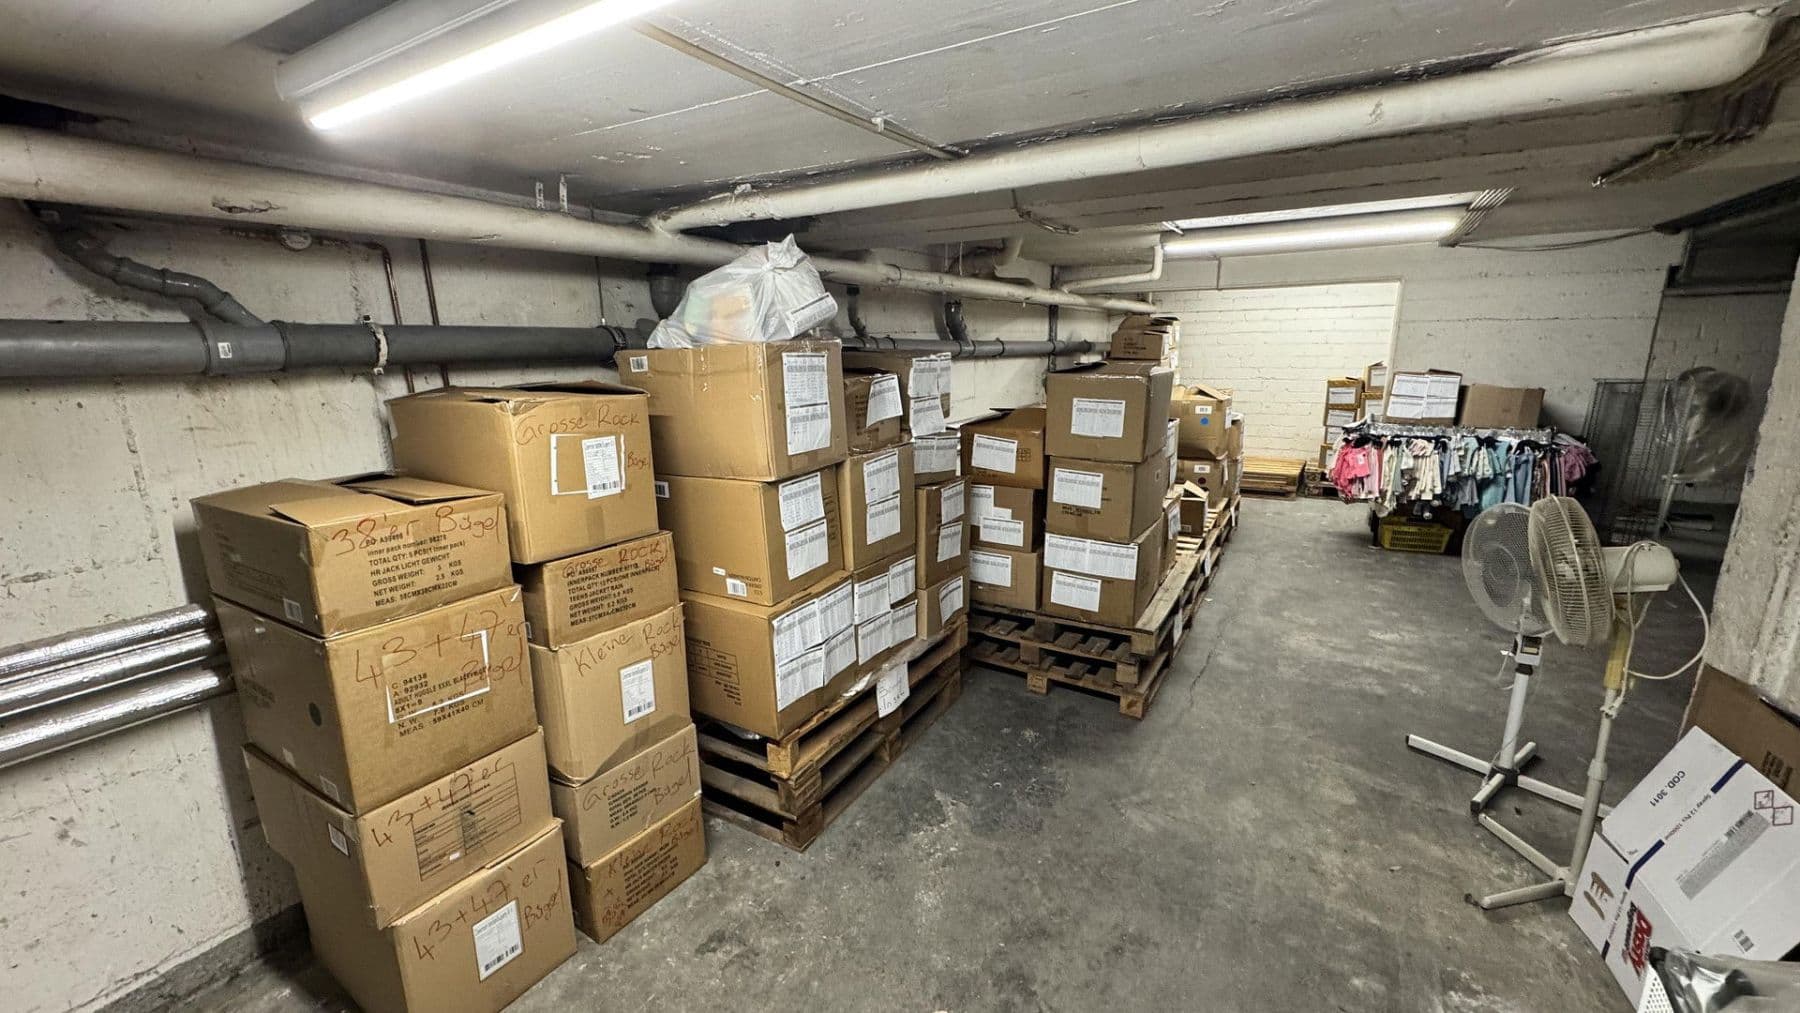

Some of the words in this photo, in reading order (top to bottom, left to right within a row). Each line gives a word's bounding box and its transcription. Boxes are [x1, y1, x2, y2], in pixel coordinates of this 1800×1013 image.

[515, 415, 588, 445] Grosse
[435, 505, 502, 545] Bügel
[369, 556, 391, 566] TOTAL
[392, 553, 408, 563] QTY:
[382, 564, 400, 575] JACK
[402, 560, 420, 570] LICHT
[422, 553, 450, 567] GEWICHT
[372, 577, 396, 587] GROSS
[398, 570, 424, 582] WEIGHT:
[374, 588, 388, 597] NET
[388, 581, 416, 593] WEIGHT:
[568, 586, 586, 595] TOTAL
[570, 611, 582, 619] NET
[575, 633, 633, 677] Kleine
[471, 698, 484, 708] CM
[1664, 770, 1686, 789] COD.
[1650, 790, 1668, 807] 3011
[413, 920, 452, 962] 43
[456, 908, 468, 922] +
